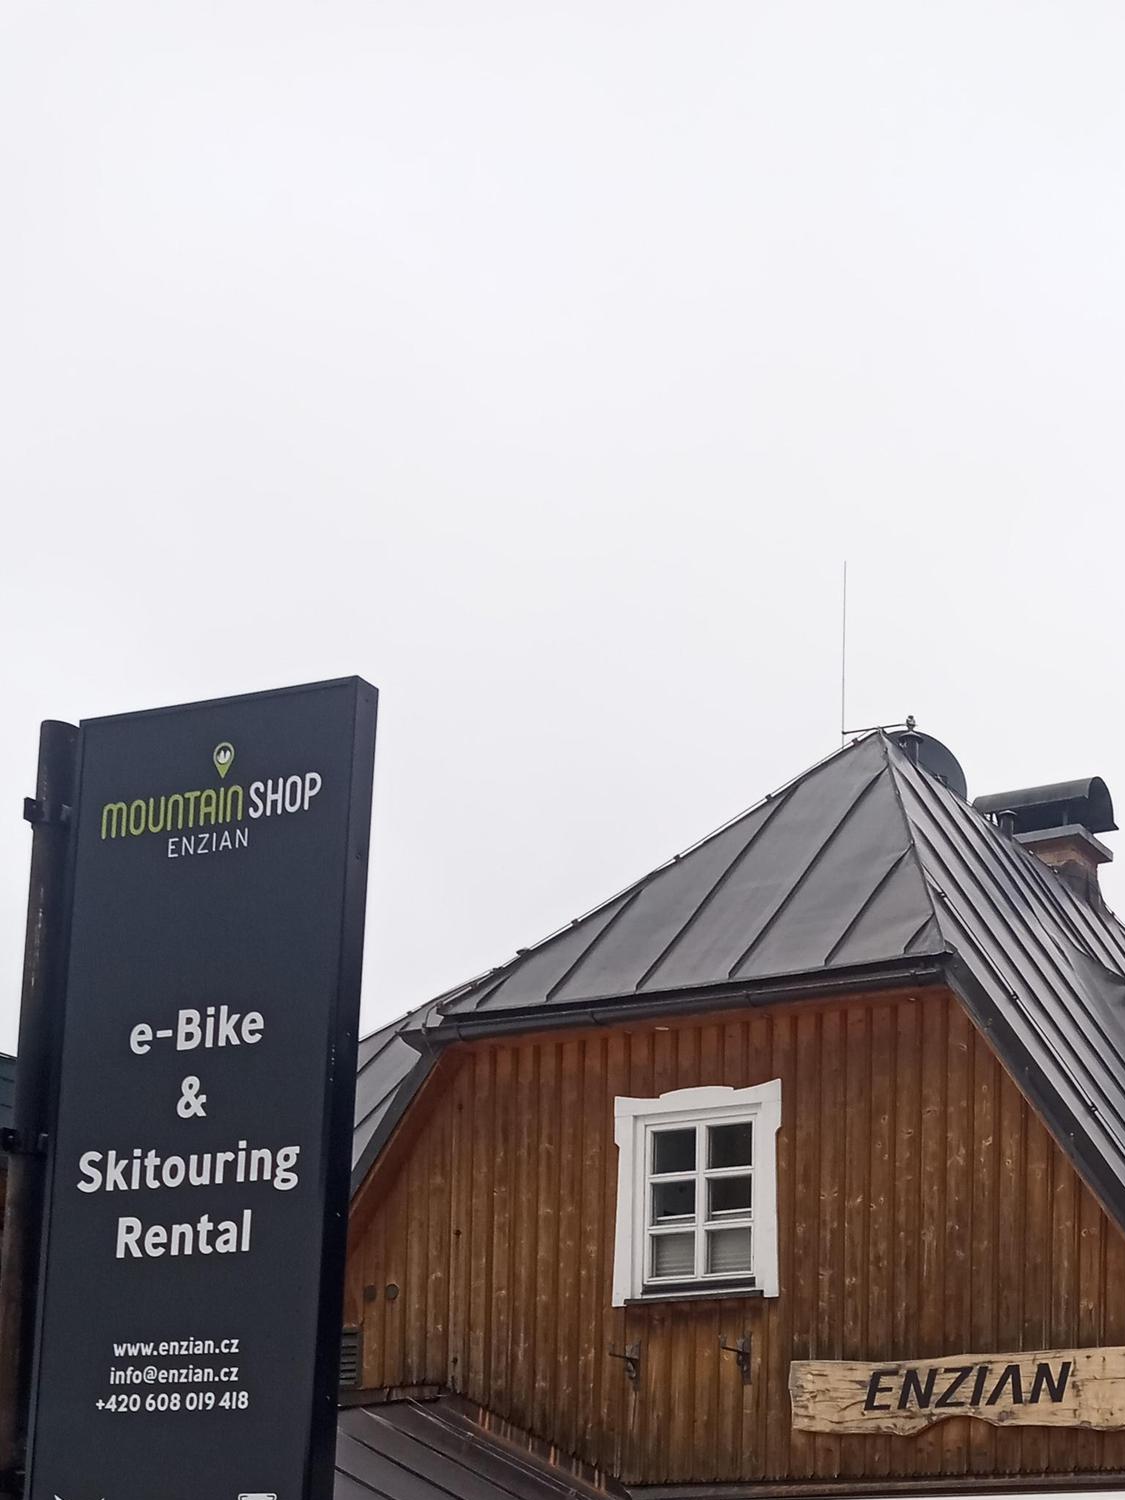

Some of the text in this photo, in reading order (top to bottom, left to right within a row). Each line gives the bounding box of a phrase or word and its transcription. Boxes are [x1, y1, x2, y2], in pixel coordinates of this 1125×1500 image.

[101, 772, 322, 840] MOUNTAIN SHOP
[167, 828, 249, 858] ENZIAN
[130, 1005, 265, 1055] e-Bike
[176, 1075, 207, 1119] &
[76, 1140, 300, 1193] Skitouring
[116, 1209, 252, 1259] Rental
[113, 1336, 240, 1357] www.enzian.cz
[109, 1364, 239, 1385] info@enzian.cz
[862, 1361, 1072, 1412] ENZIAN
[96, 1390, 249, 1413] +420 608 019 418
